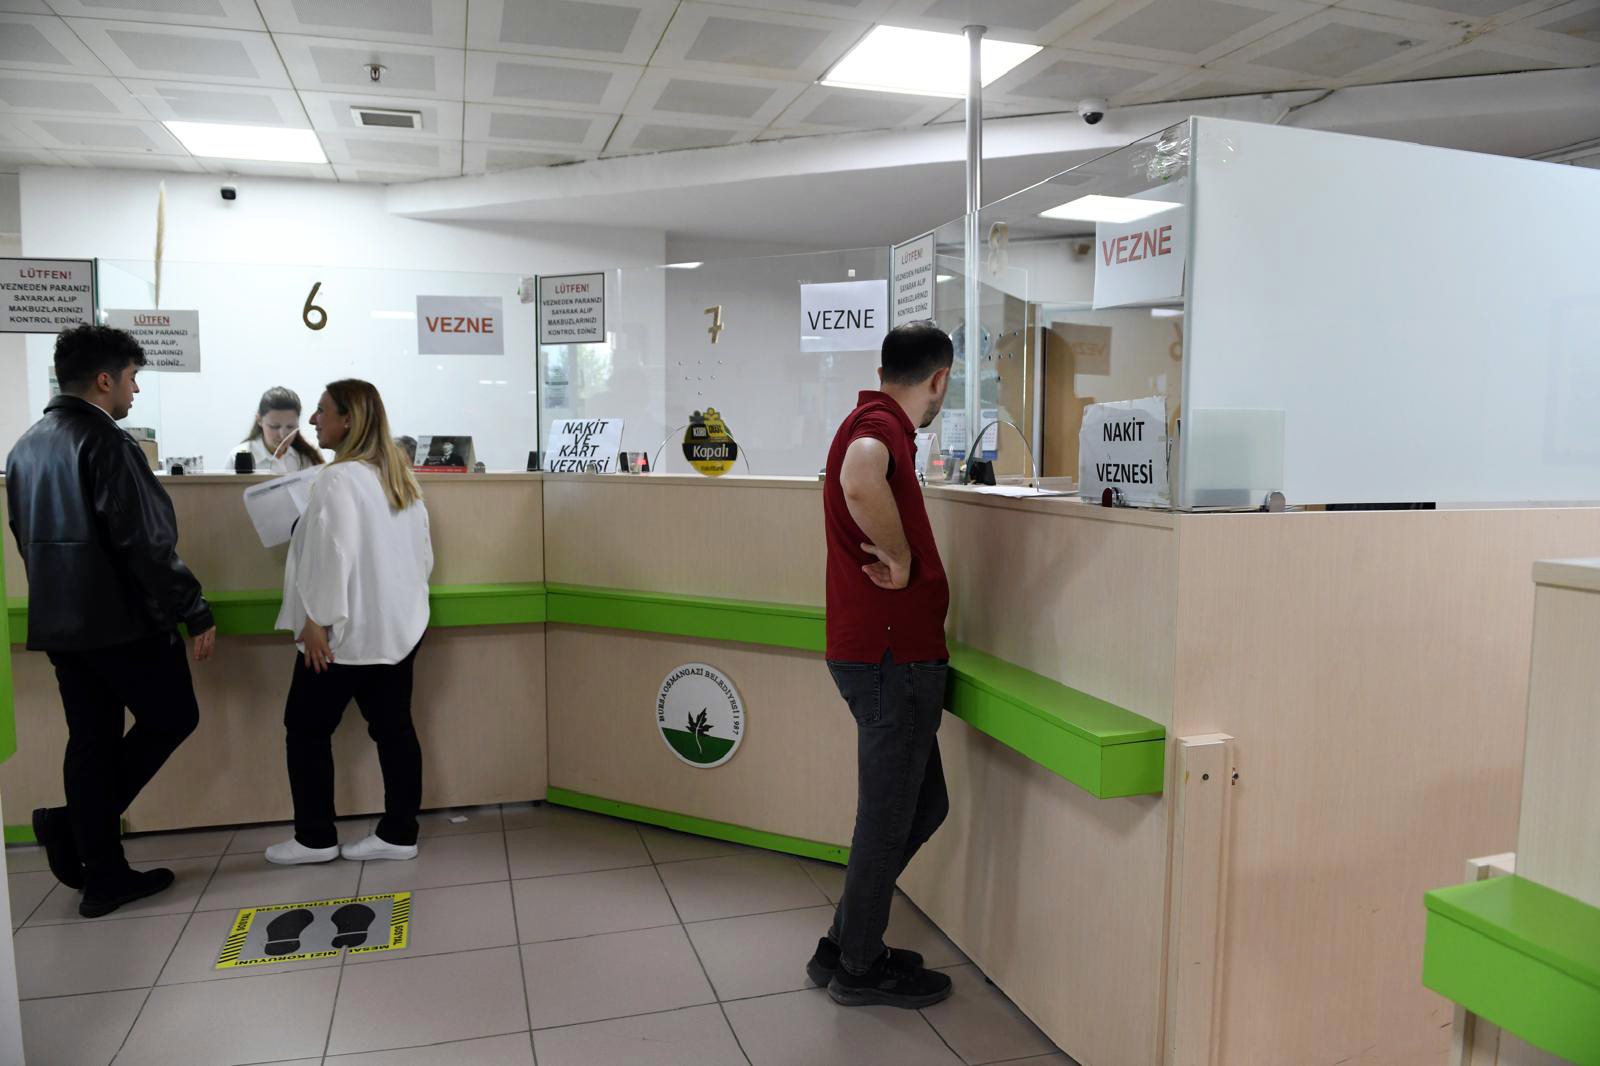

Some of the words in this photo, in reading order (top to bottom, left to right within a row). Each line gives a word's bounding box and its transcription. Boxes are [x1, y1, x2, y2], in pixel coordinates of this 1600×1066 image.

[1102, 224, 1173, 267] VEZNE
[20, 267, 72, 280] LÜTFEN!
[0, 283, 47, 292] VEZNEDEN
[50, 284, 90, 292] PARANIZI
[554, 283, 590, 295] LÜTFEN!
[302, 281, 328, 331] 6
[543, 298, 573, 306] VEZNEDEN
[574, 296, 602, 305] PARANIZI
[9, 305, 84, 314] MAKBUZLARINIZI
[551, 308, 578, 316] SAYARAK
[579, 307, 594, 315] ALIP
[9, 316, 52, 324] KONTROL
[134, 314, 171, 326] LÜTFEN
[425, 316, 494, 334] VEZNE
[548, 317, 597, 326] MAKBUZLARINIZI
[704, 305, 725, 344] 7
[808, 309, 875, 331] VEZNE
[548, 328, 576, 336] KONTROL
[577, 326, 597, 336] EDİNİZ
[562, 418, 609, 434] NAKİT
[1103, 416, 1145, 442] NAKİT
[574, 433, 592, 446] VE
[559, 445, 600, 458] KART
[693, 444, 729, 461] Kapalı
[1096, 459, 1154, 485] VEZNESİ
[658, 693, 668, 722] BURSA
[663, 668, 704, 693] OSMANGAZİ
[256, 901, 330, 913] MESAFENİZİ
[333, 893, 396, 906] KORUYUN!
[236, 912, 253, 932] SOSYAL
[393, 924, 404, 947] SOSYAL
[234, 953, 307, 966] KORUYUN!
